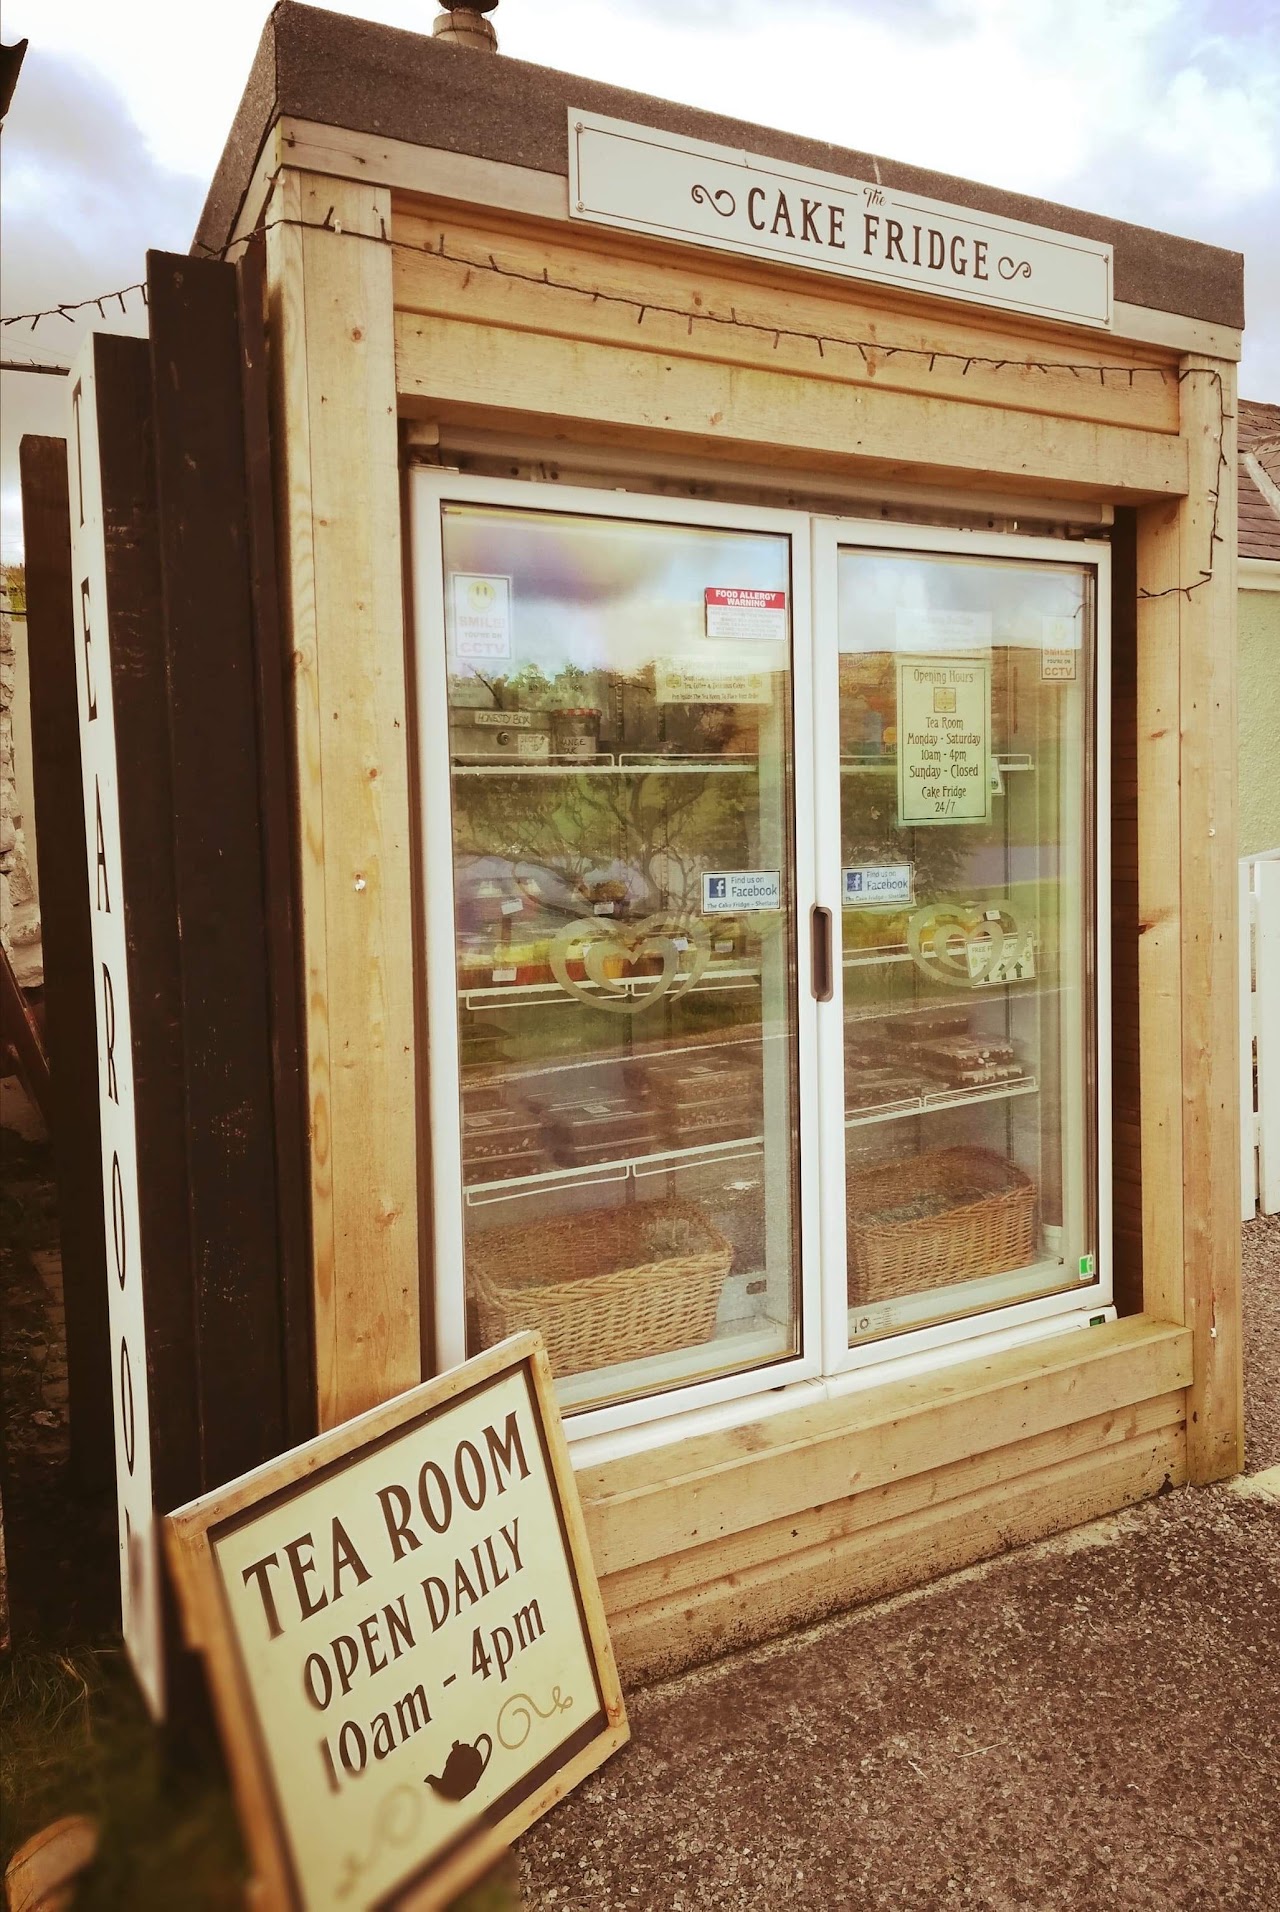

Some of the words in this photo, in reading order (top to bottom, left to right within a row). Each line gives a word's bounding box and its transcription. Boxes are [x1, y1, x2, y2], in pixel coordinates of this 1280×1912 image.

[863, 186, 887, 208] The
[747, 187, 846, 250] CAKE
[863, 213, 989, 281] FRIDGE
[715, 590, 738, 598] FOOD
[740, 591, 776, 601] ALLERGY
[727, 598, 766, 608] WARNING
[460, 643, 505, 654] CCTV
[914, 669, 947, 684] Opening
[949, 670, 974, 683] Hours
[1044, 667, 1072, 676] CCTV
[513, 714, 531, 725] BOX
[926, 717, 939, 728] Tea
[942, 717, 964, 730] Room
[907, 733, 938, 746] Monday
[946, 733, 981, 746] Saturday
[921, 750, 941, 762] 10am
[949, 749, 967, 762] 4pm
[909, 765, 941, 780] Sunday
[951, 764, 979, 779] Closed
[922, 786, 940, 799] Cake
[942, 786, 967, 798] Fridge
[935, 799, 956, 814] 24/7
[731, 876, 745, 884] Find
[867, 878, 908, 890] Facebook
[732, 884, 778, 897] Facebook
[242, 1515, 373, 1641] TEA
[376, 1410, 532, 1564] ROOM
[304, 1594, 416, 1711] OPEN
[422, 1516, 526, 1633] DAILY
[319, 1683, 433, 1795] 10am
[443, 1672, 457, 1689] -
[471, 1597, 546, 1684] 4pm
